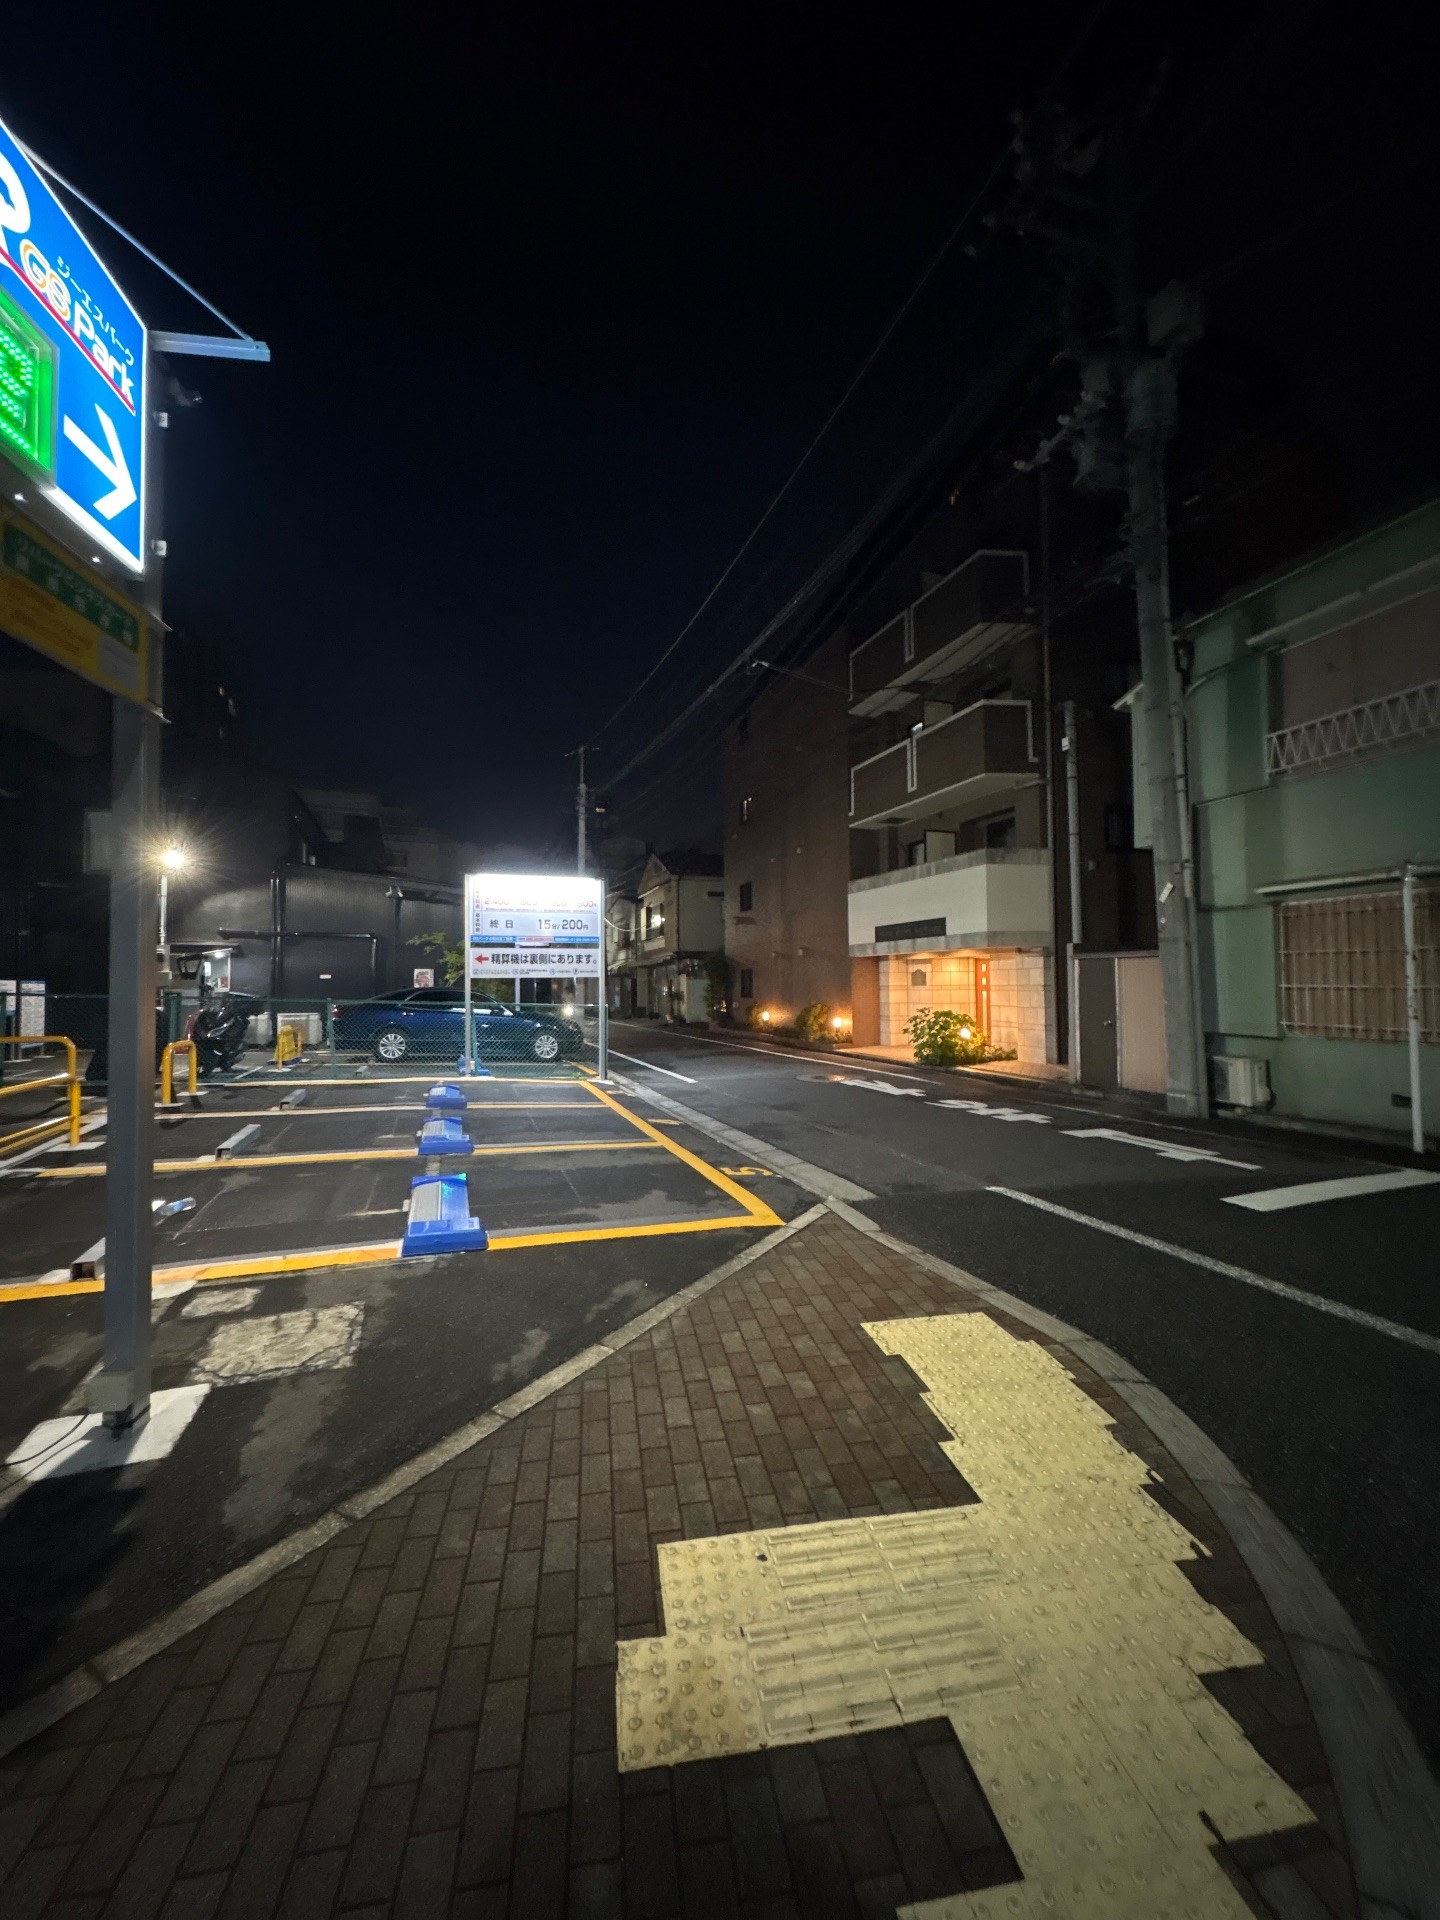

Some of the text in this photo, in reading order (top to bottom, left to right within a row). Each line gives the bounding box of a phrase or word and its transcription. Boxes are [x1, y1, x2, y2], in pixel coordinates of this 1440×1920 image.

[57, 256, 134, 366] ジーエスパーク
[491, 953, 597, 964] 精算機は裏側にあります。
